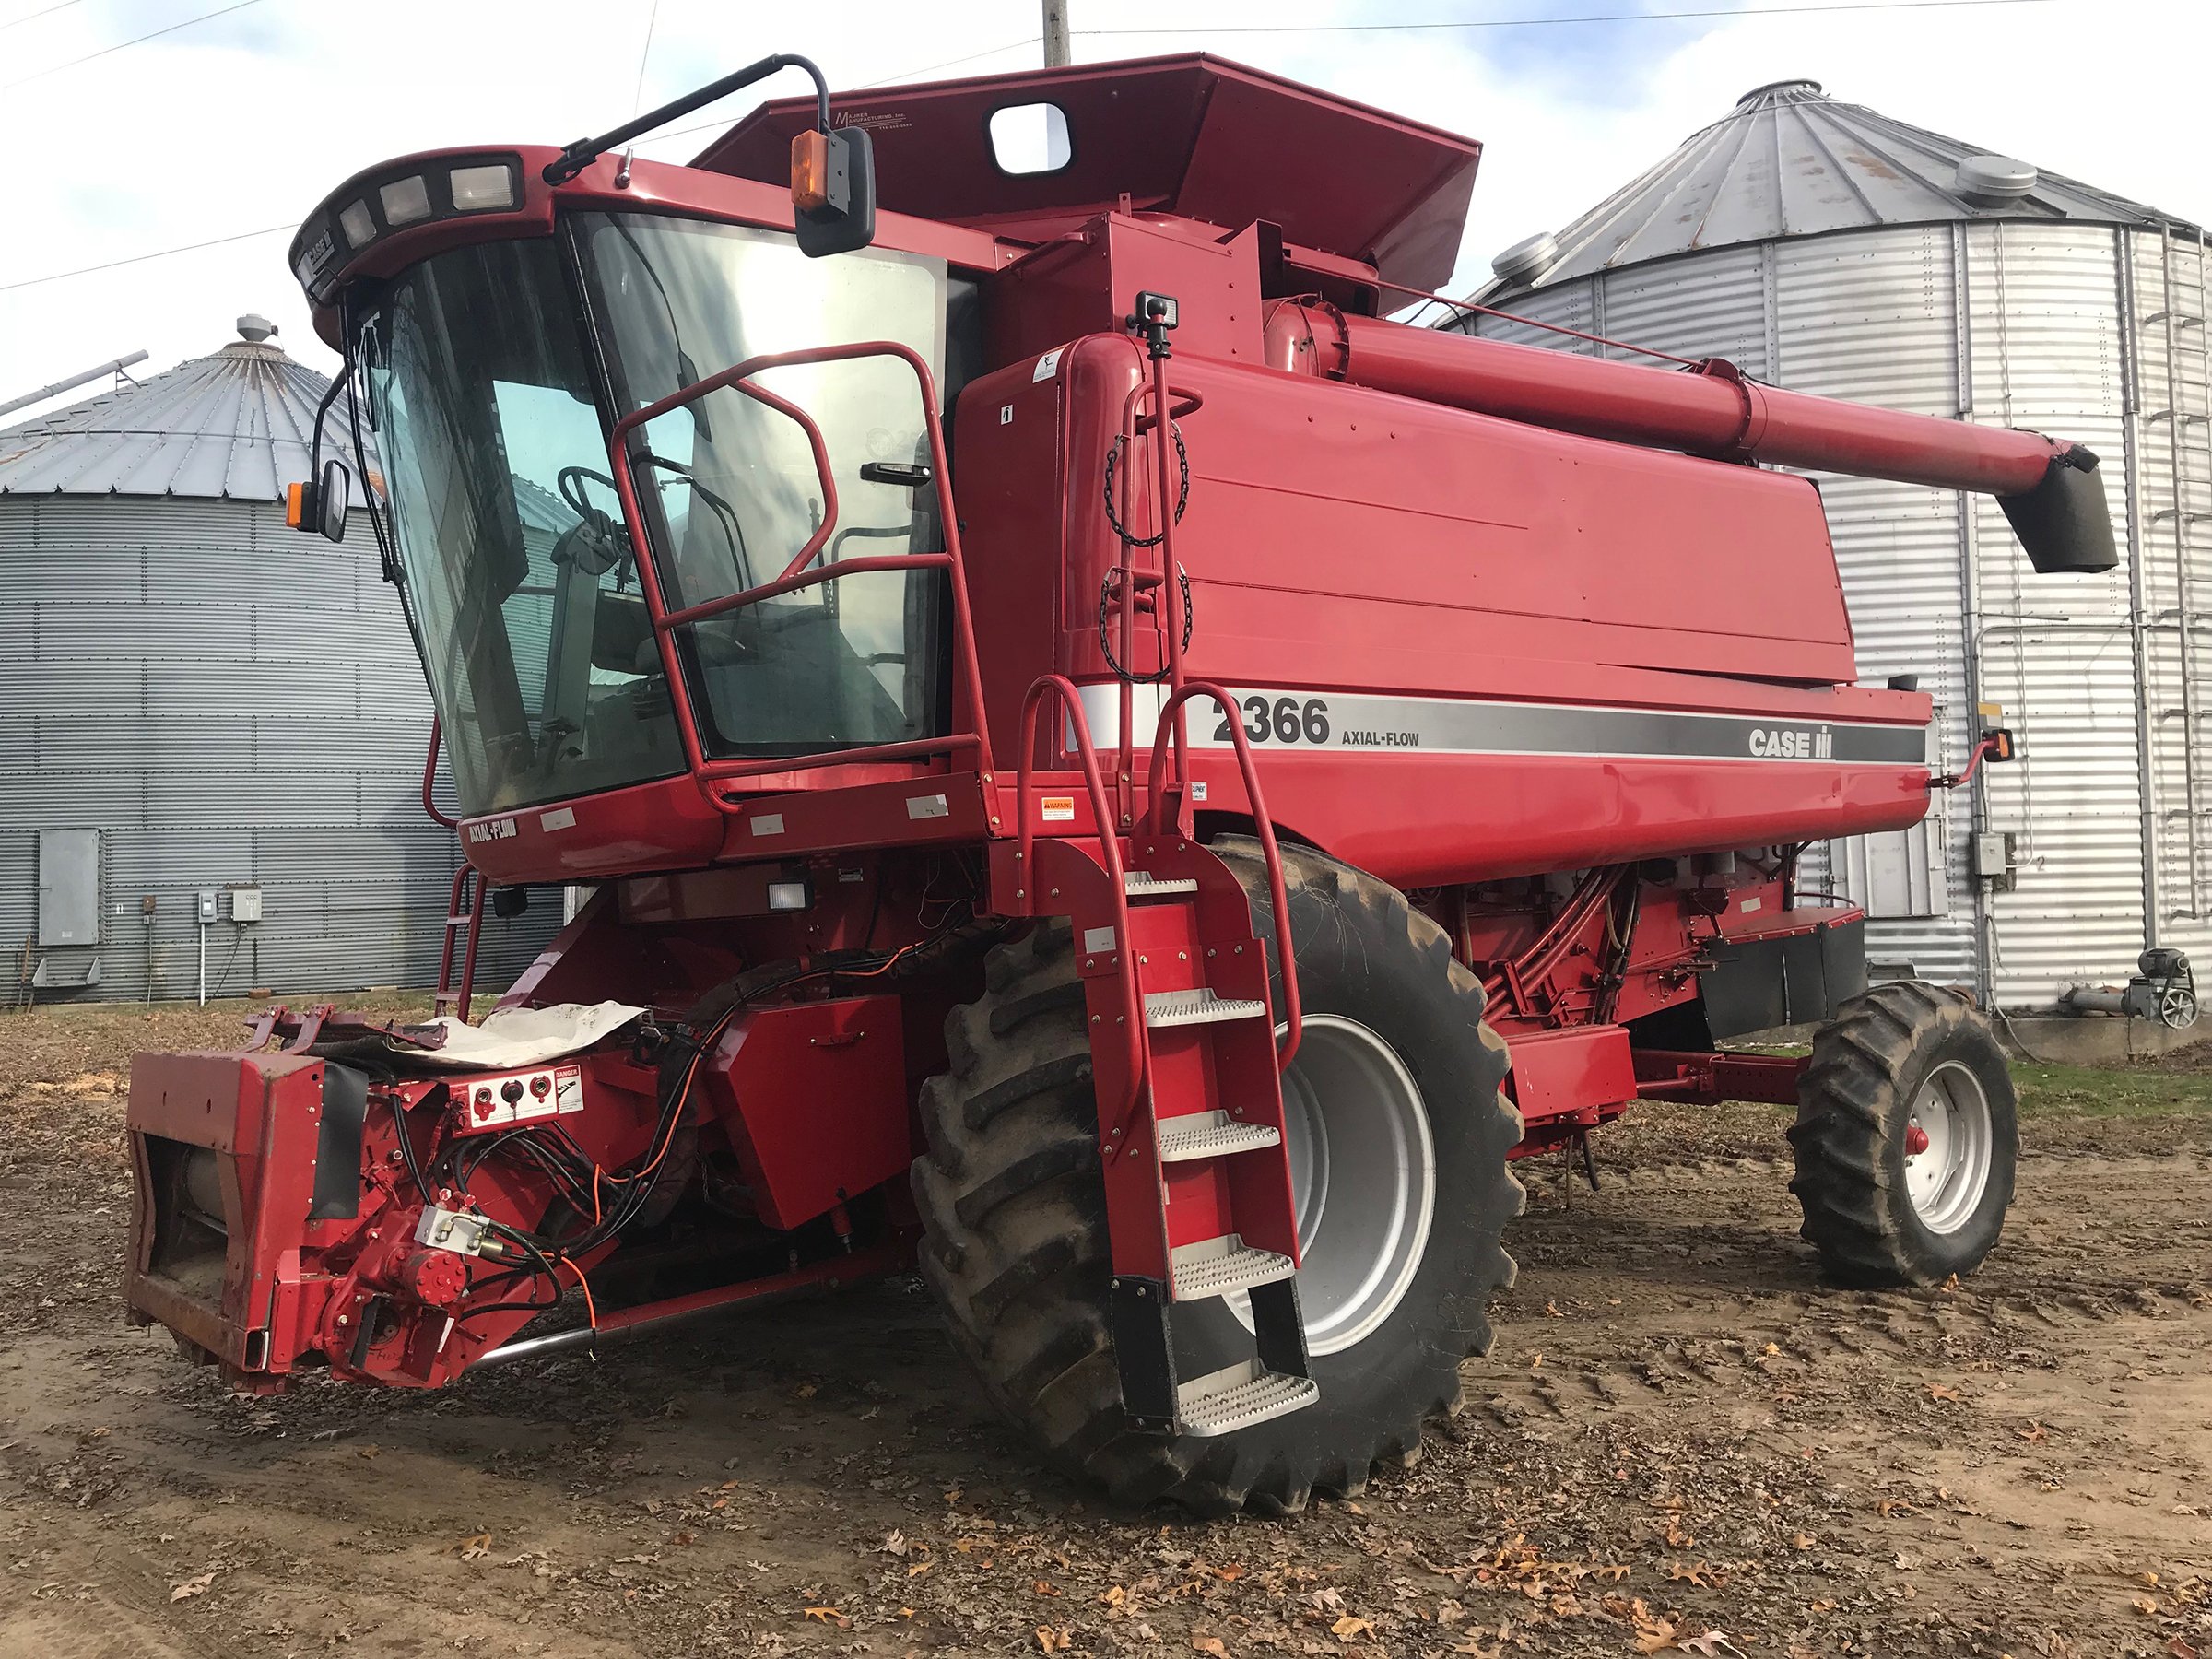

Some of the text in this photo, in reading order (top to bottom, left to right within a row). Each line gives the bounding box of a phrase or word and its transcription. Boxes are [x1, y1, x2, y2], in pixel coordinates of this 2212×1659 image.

[308, 237, 326, 266] CASE
[1212, 695, 1419, 747] 2366 AXIAL-FLOW
[1748, 728, 1810, 758] CASE
[1050, 802, 1073, 810] WARNING
[469, 818, 516, 843] AXIAL-FLOW
[556, 1069, 578, 1078] DANGER
